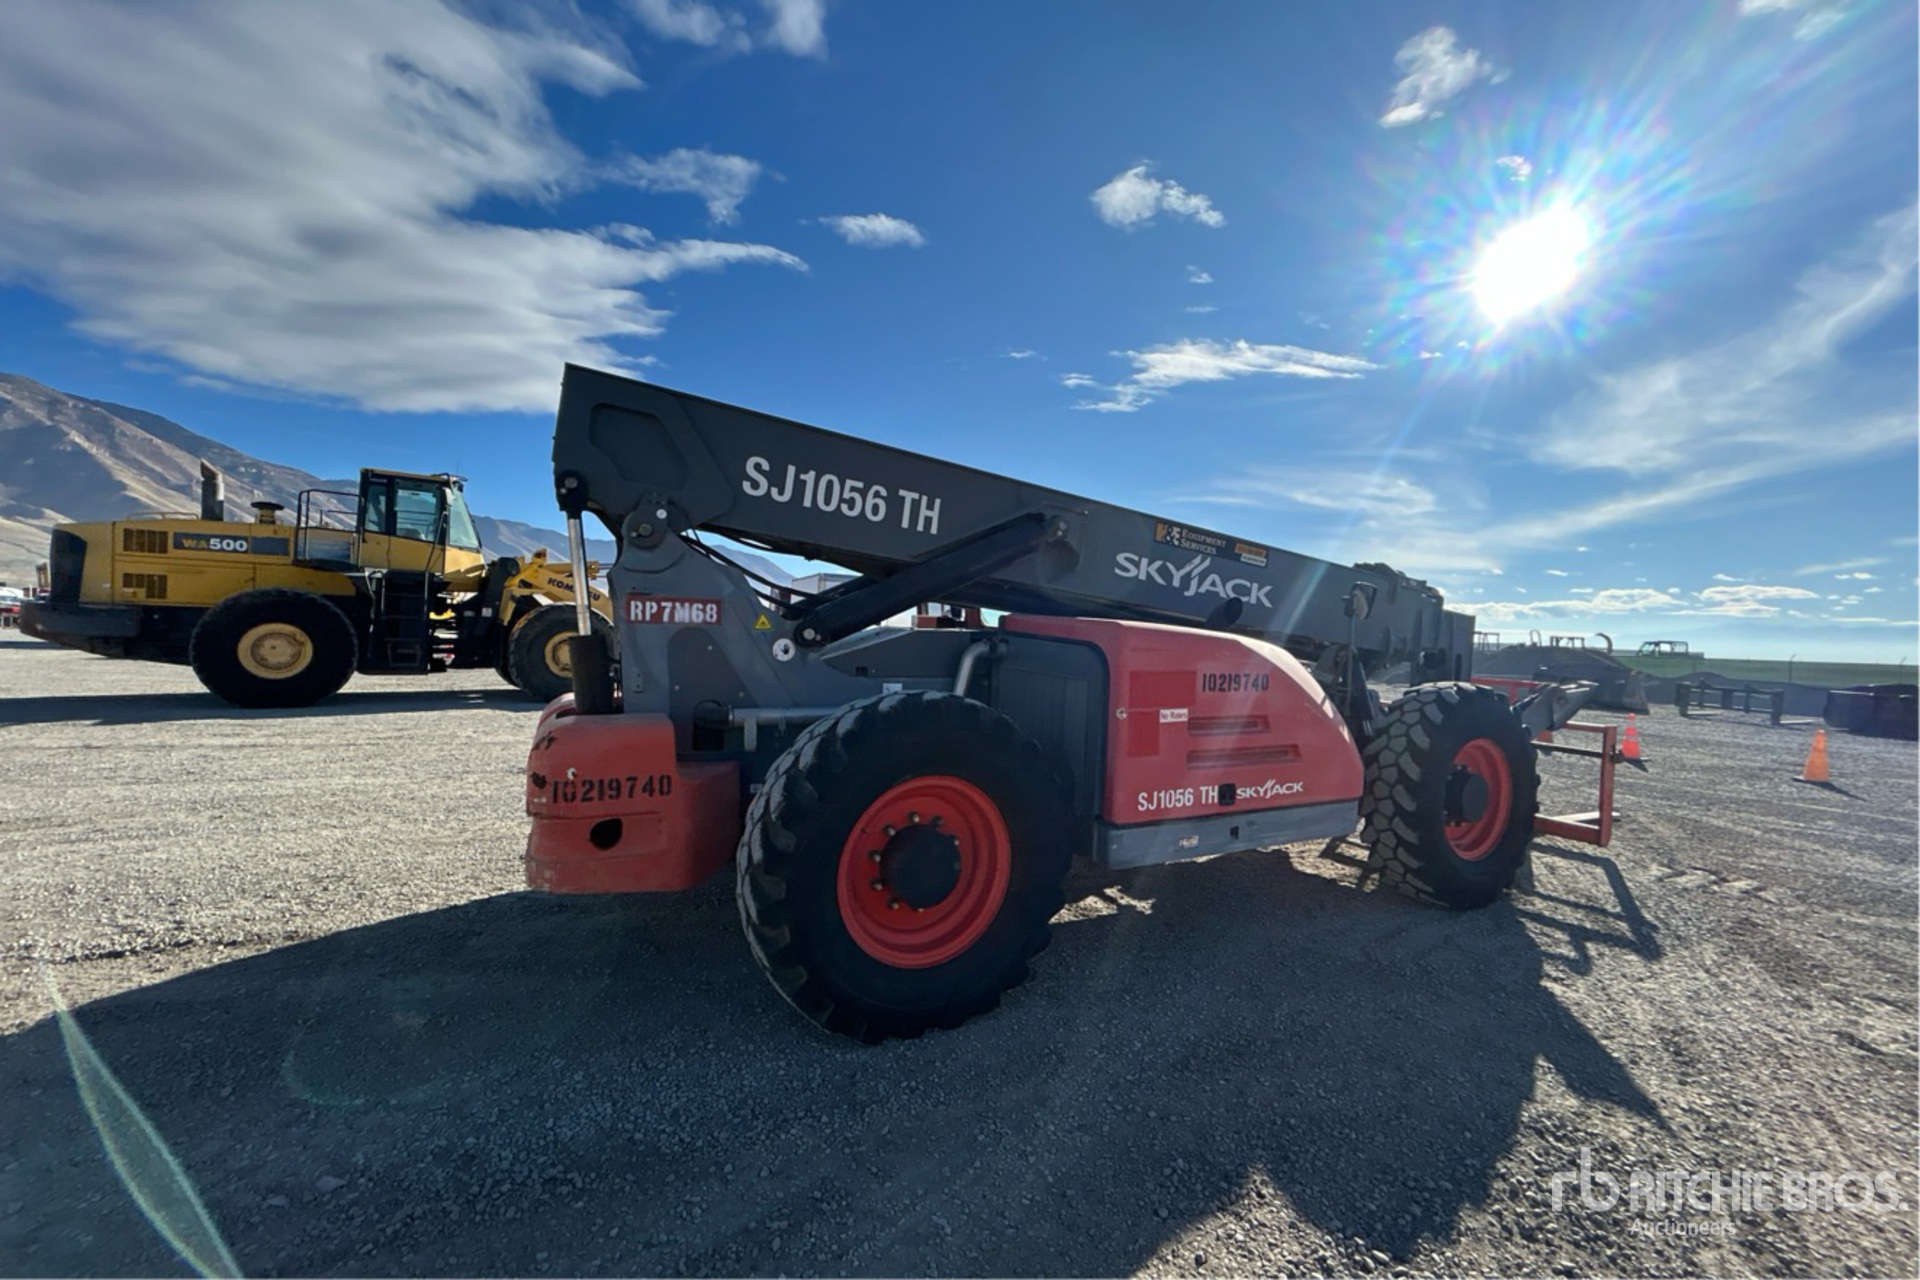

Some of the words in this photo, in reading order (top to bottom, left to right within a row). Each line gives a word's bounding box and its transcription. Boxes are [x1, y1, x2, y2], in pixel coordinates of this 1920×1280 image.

[742, 456, 888, 522] SJ1056
[898, 489, 941, 535] TH
[547, 577, 601, 601] KOMU
[1114, 552, 1273, 608] SKYJACK
[630, 600, 718, 624] RP7M68
[1202, 673, 1269, 692] 10219740
[552, 774, 672, 804] 10219740
[1137, 787, 1194, 811] SJ1056
[1200, 784, 1219, 804] TH
[1236, 779, 1303, 799] SKYJACK
